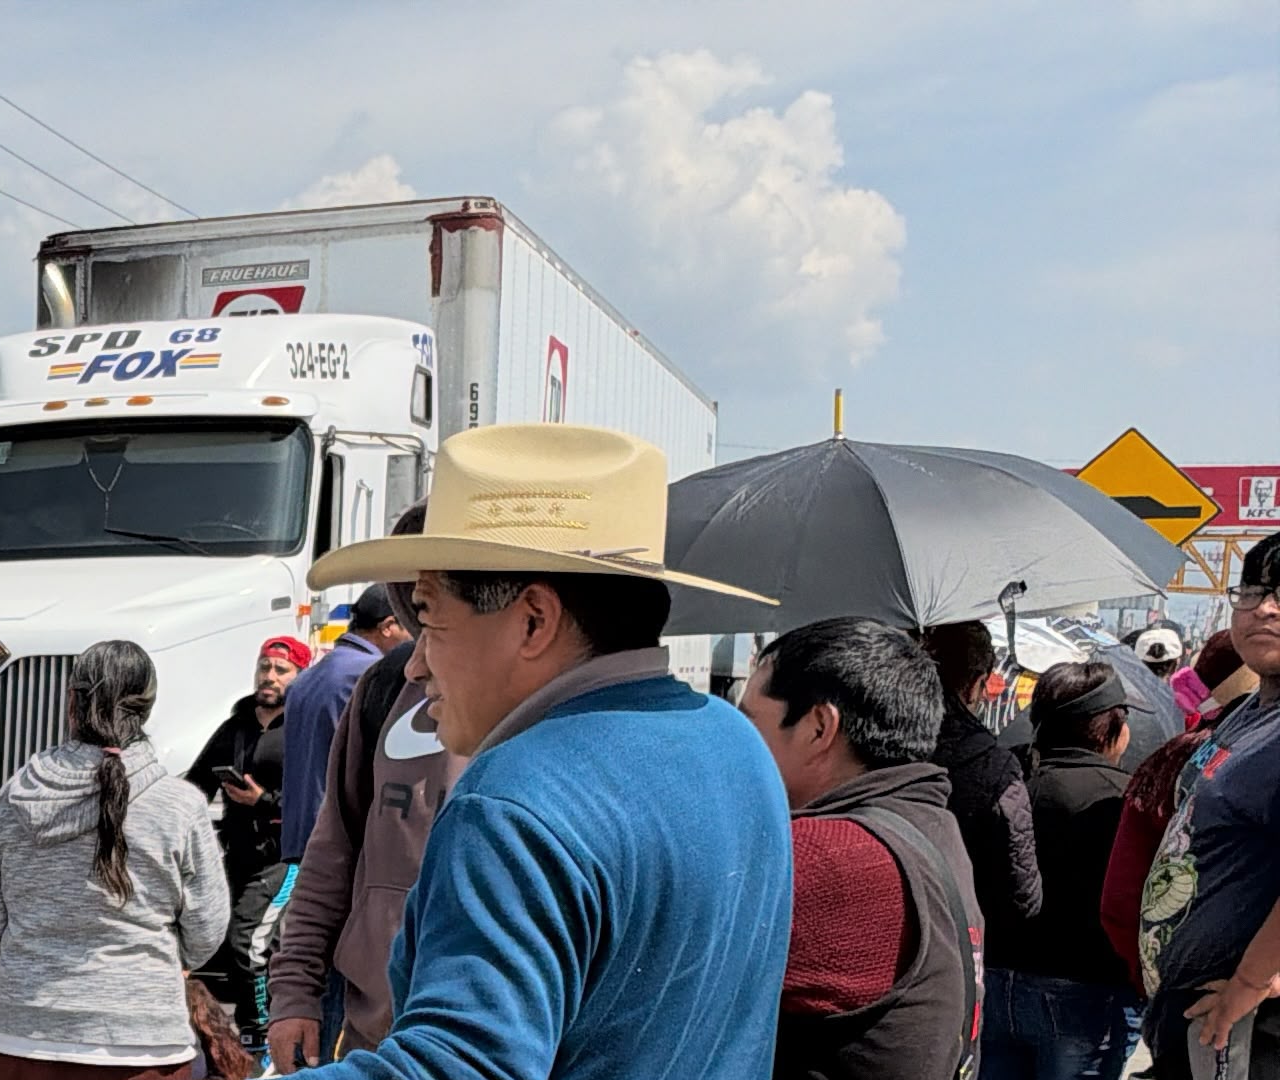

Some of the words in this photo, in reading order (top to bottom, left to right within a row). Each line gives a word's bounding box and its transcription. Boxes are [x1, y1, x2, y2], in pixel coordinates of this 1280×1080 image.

[209, 264, 300, 282] FRUEHAUF
[28, 330, 142, 358] SPD
[169, 327, 221, 344] 68
[77, 348, 195, 384] FOX
[286, 341, 350, 379] 324-EG-2
[469, 382, 480, 428] 69
[1246, 508, 1277, 518] KFC
